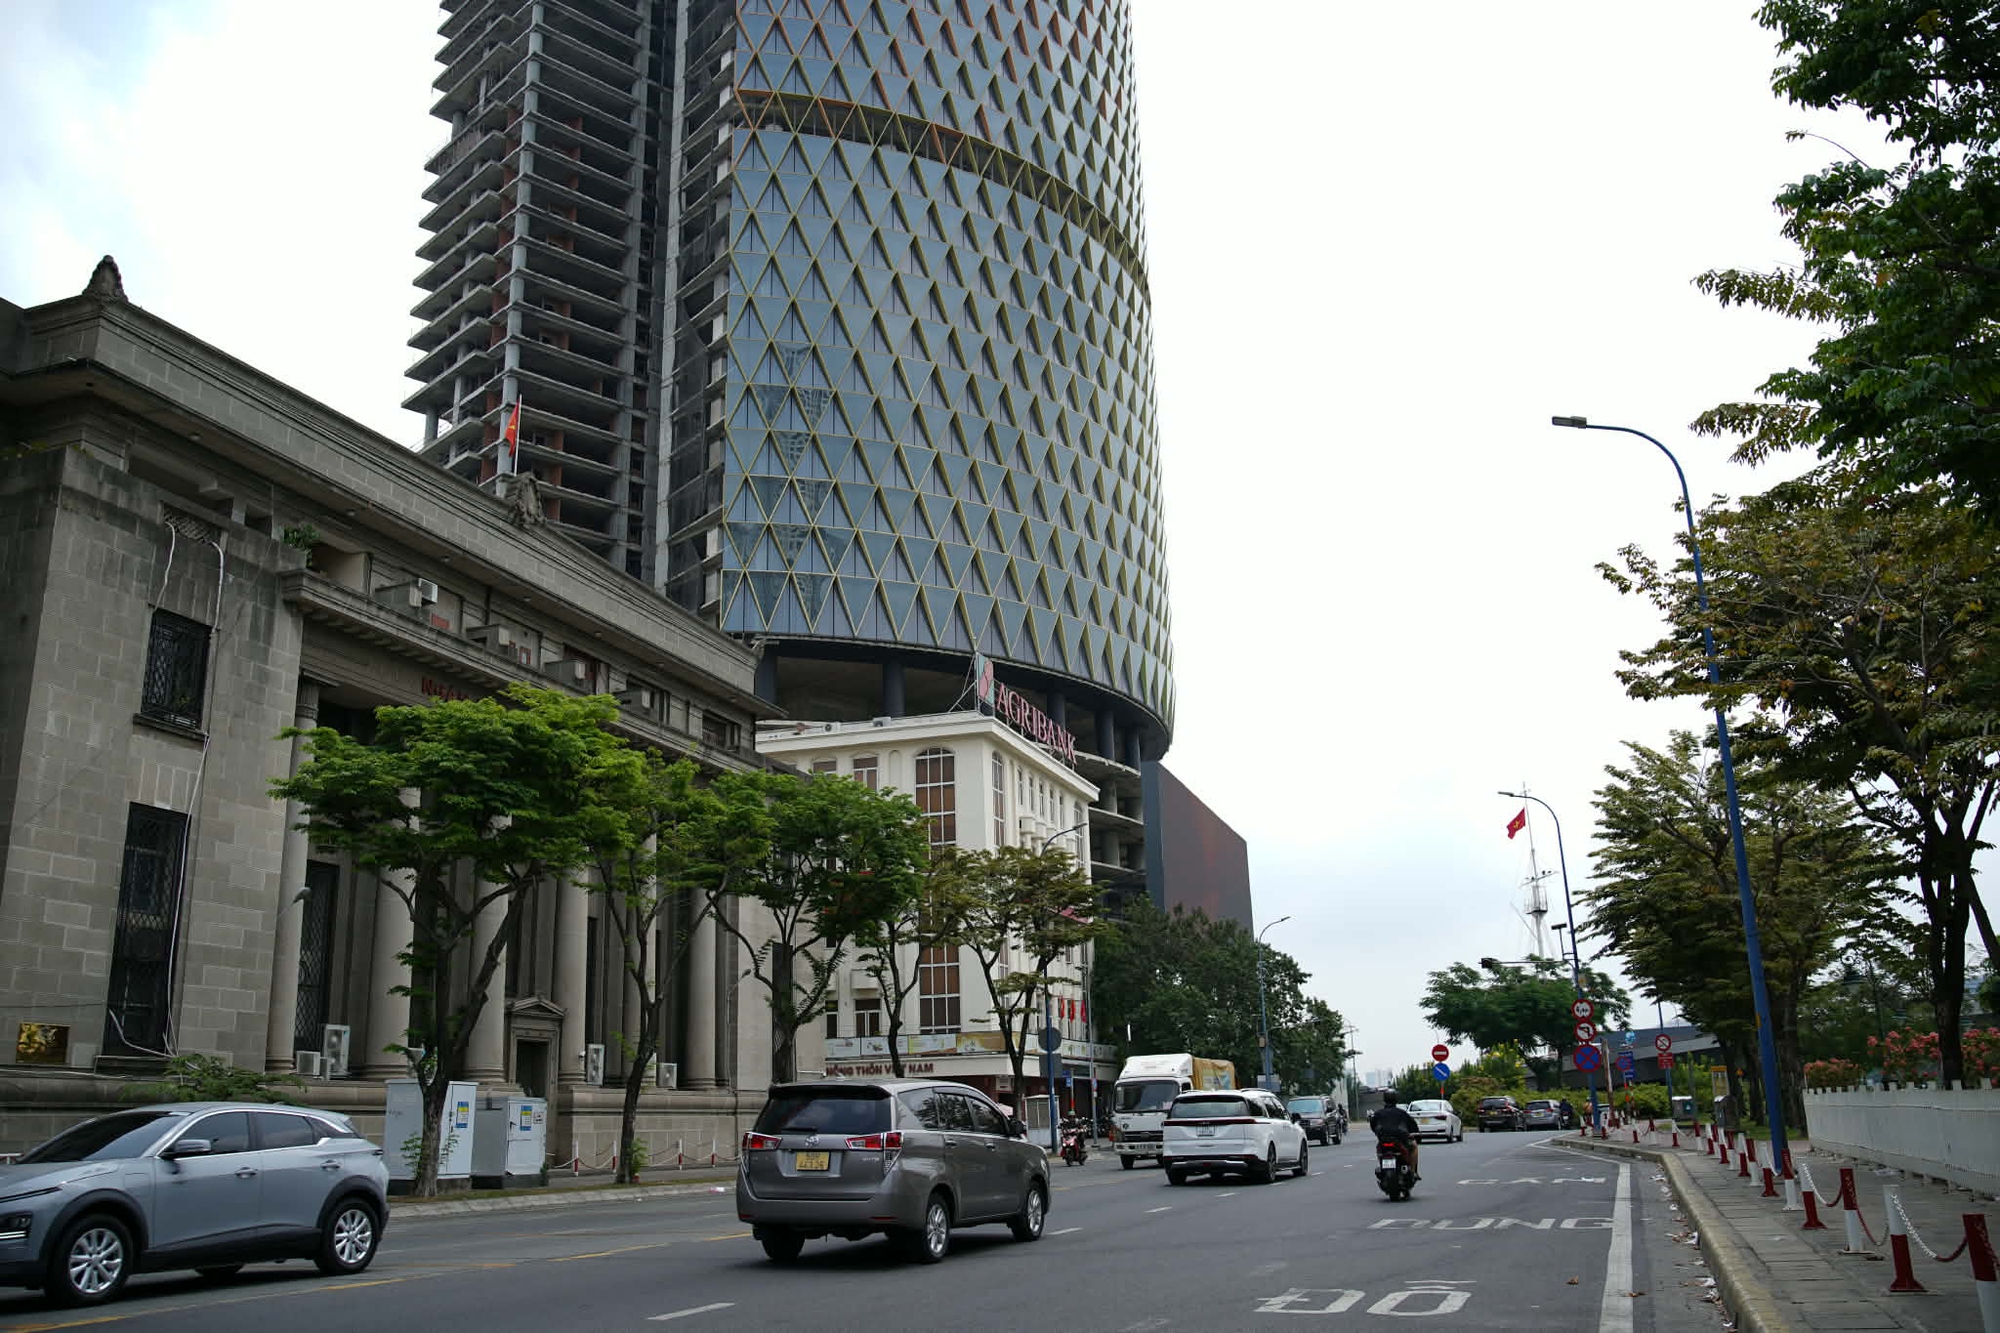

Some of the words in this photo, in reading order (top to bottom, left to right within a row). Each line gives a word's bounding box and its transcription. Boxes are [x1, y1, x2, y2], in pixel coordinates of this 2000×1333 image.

[997, 682, 1078, 766] AGRIBANK
[856, 1062, 882, 1075] THÔN
[909, 1062, 934, 1073] NAM
